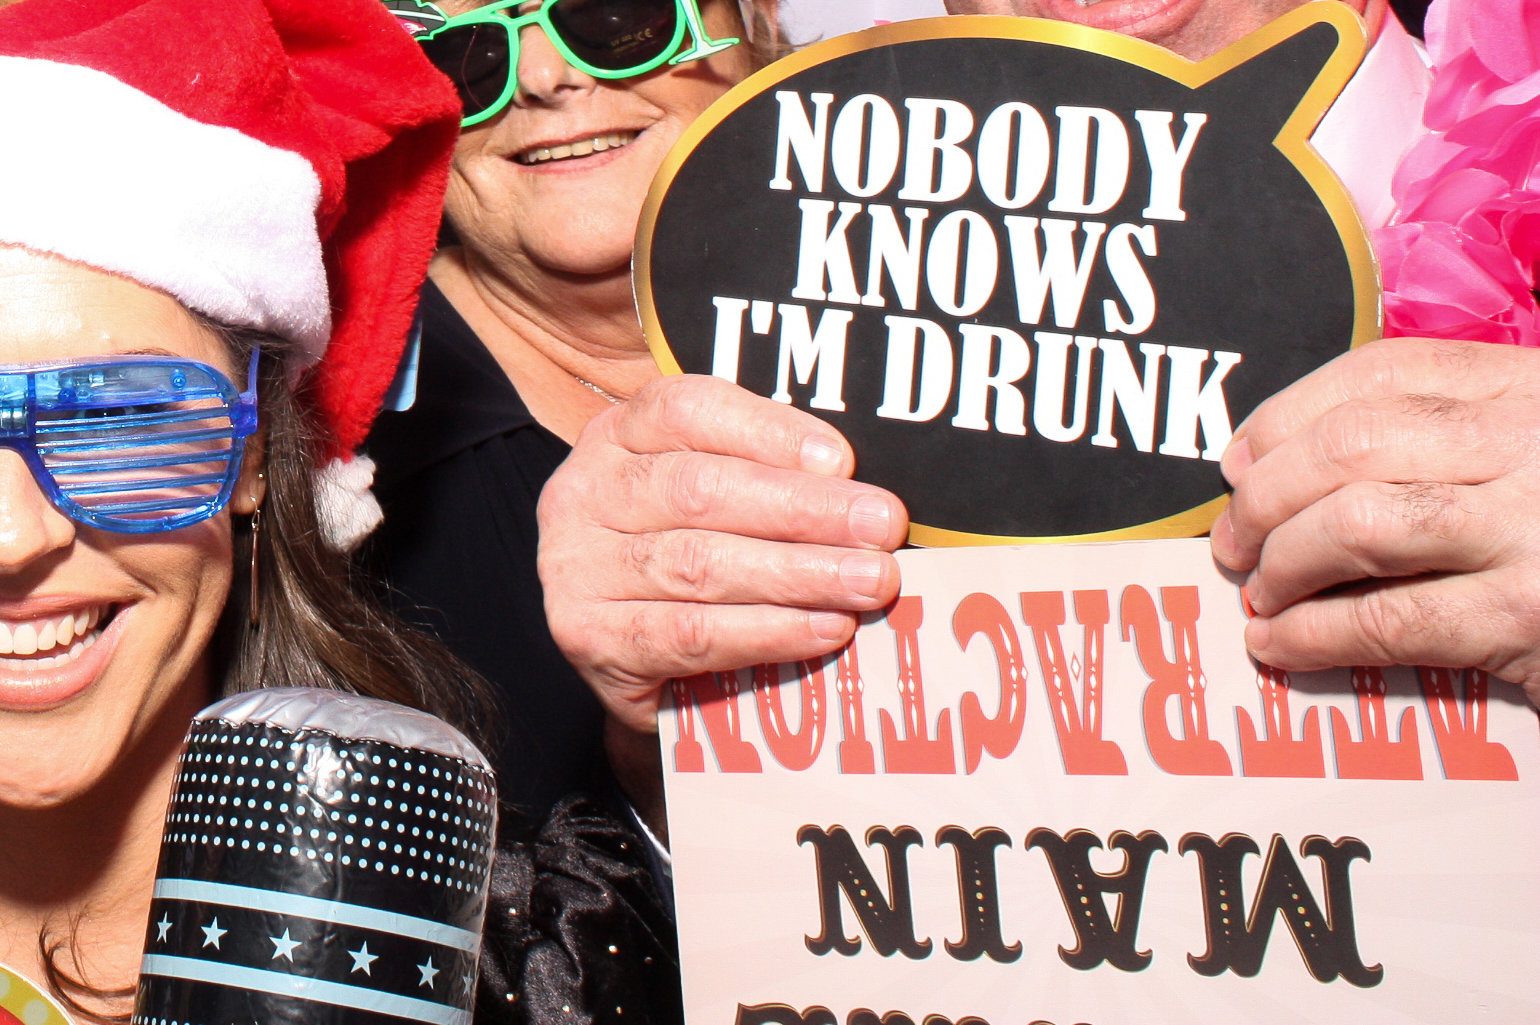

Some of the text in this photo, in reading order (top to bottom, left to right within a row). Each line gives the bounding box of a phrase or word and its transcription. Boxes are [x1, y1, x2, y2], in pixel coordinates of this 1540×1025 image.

[637, 27, 653, 41] CE
[770, 90, 1208, 222] NOBODY
[792, 198, 1158, 335] KNOWS
[712, 296, 1242, 463] I'M DRUNK
[796, 824, 1384, 988] MAIN
